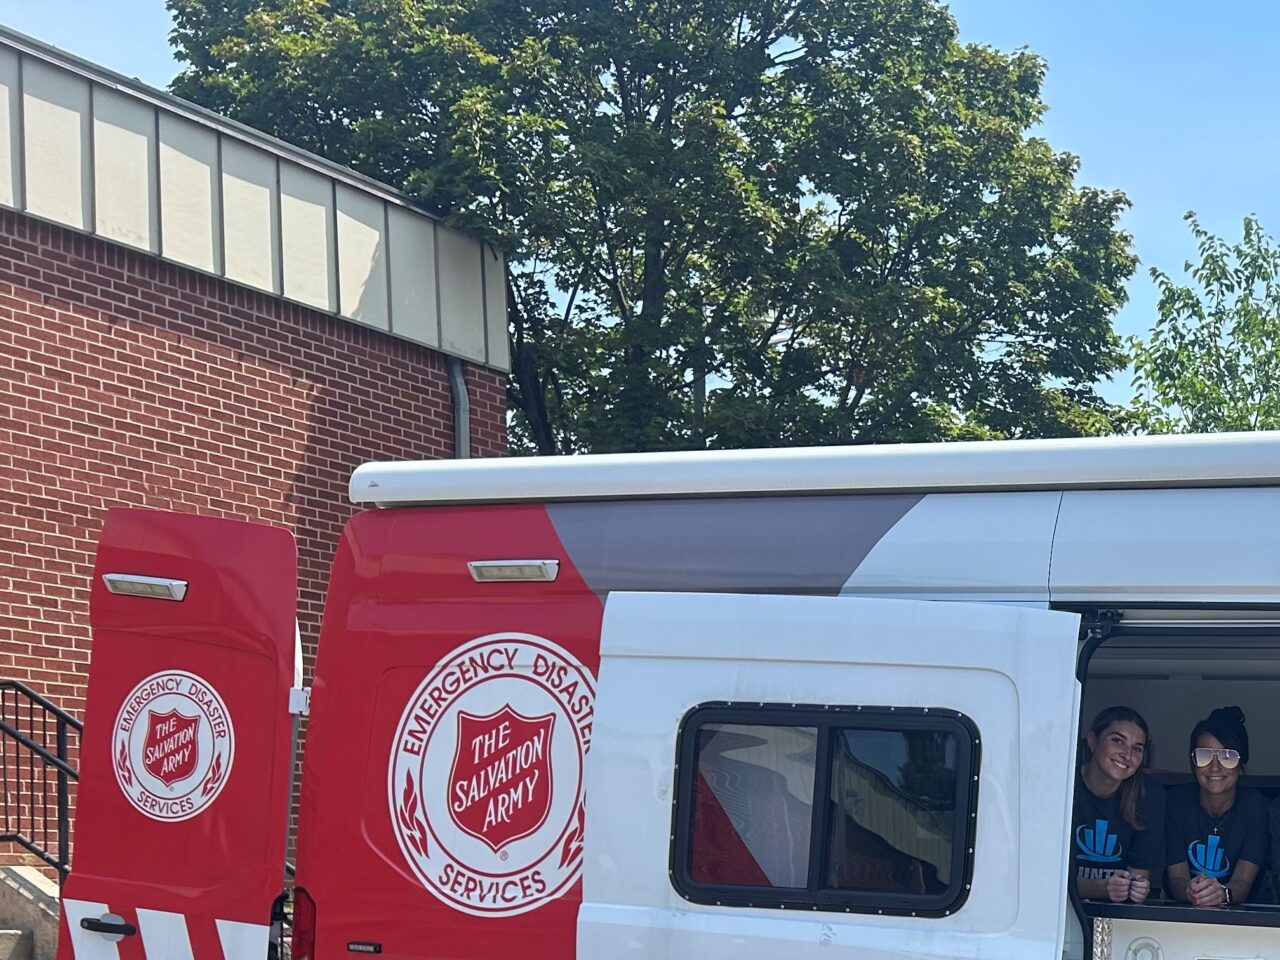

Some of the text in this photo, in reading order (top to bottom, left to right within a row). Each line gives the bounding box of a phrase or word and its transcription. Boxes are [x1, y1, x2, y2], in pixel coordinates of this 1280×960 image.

[120, 678, 227, 739] EMERGENCY DISASTER
[402, 647, 519, 757] EMERGENCY
[146, 723, 195, 765] SALVATION
[155, 717, 177, 739] THE
[471, 720, 512, 765] THE
[160, 744, 192, 776] ARMY
[453, 728, 545, 813] SALVATION
[137, 791, 194, 815] SERVICES
[482, 769, 540, 833] ARMY
[438, 863, 547, 904] SERVICES
